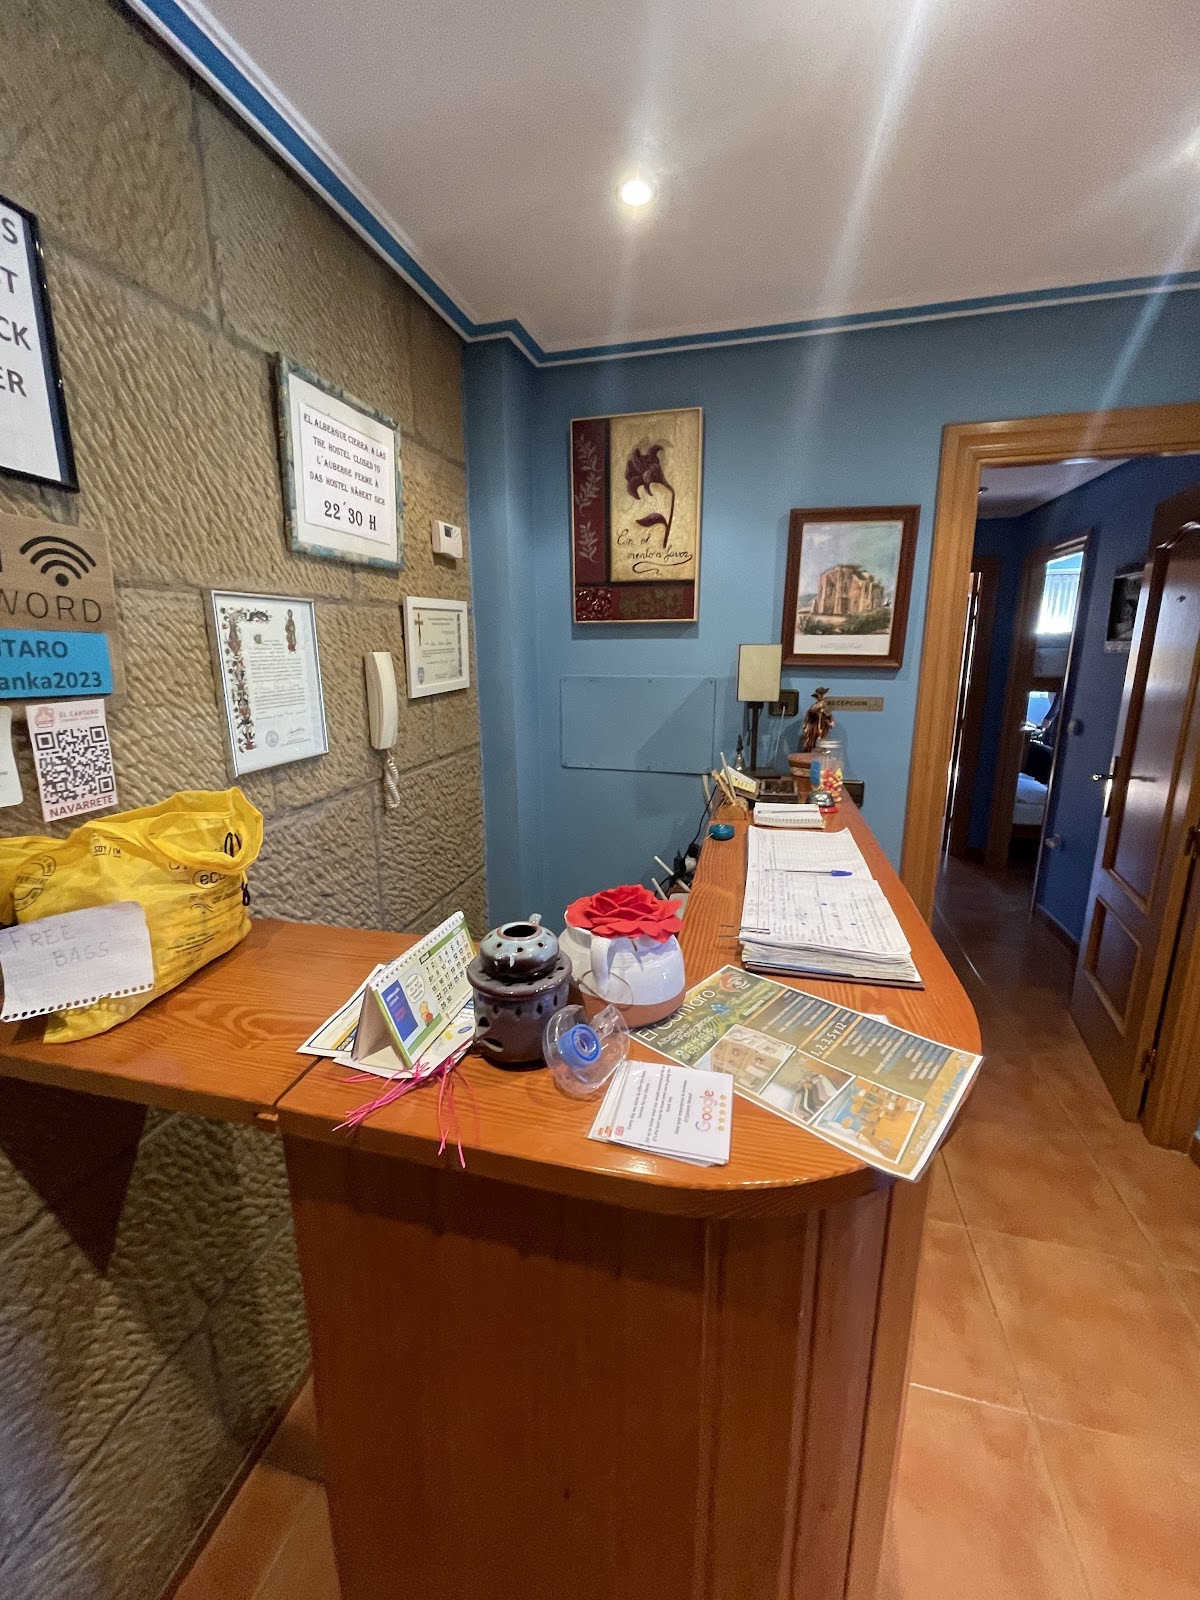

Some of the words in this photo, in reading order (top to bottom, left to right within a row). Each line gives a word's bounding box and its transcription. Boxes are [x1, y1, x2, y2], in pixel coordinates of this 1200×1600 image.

[0, 366, 28, 398] R
[303, 412, 313, 425] EL
[314, 418, 347, 441] ALBERGUE
[348, 435, 369, 452] CIERRA
[376, 448, 386, 460] LAS
[313, 435, 325, 449] THE
[328, 443, 351, 460] HOSTEL
[353, 454, 373, 470] CLOSED
[374, 463, 381, 473] TO
[309, 470, 323, 484] DAS
[325, 476, 349, 492] HOSTEL
[354, 471, 373, 486] FERME
[369, 514, 376, 531] H
[0, 639, 69, 659] TARO
[0, 671, 102, 691] anka2023
[49, 795, 114, 818] NAVARRETE
[9, 925, 76, 951] FREE
[52, 940, 110, 968] BAGS
[636, 1028, 659, 1042] El
[657, 1023, 690, 1047] Albergue
[835, 1022, 847, 1030] 12
[695, 1090, 717, 1133] Google
